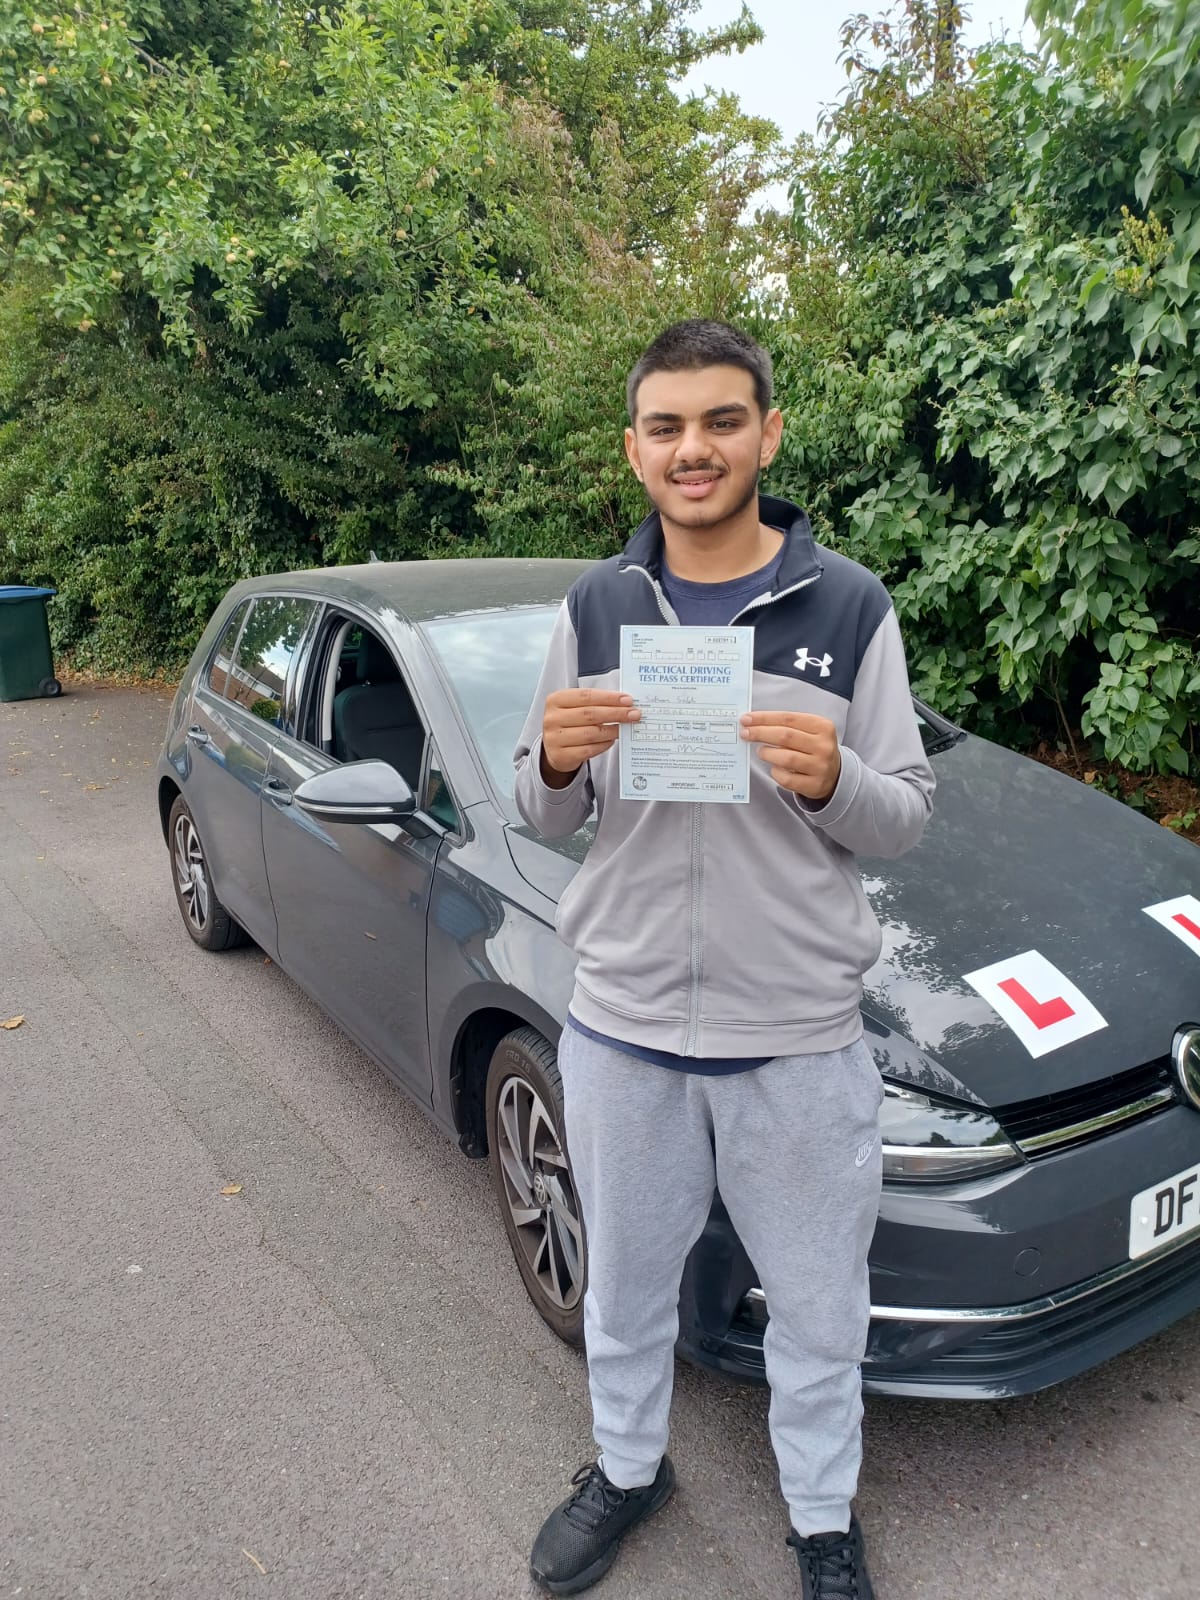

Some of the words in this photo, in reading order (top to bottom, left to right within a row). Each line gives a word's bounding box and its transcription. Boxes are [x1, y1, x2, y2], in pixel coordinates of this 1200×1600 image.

[639, 665, 688, 675] PRACTICAL
[690, 666, 731, 676] DRIVING
[640, 674, 657, 683] TEST
[659, 675, 679, 684] PASS
[680, 675, 731, 685] CERTIFICATE
[997, 977, 1076, 1030] L
[1153, 1173, 1200, 1238] DF
